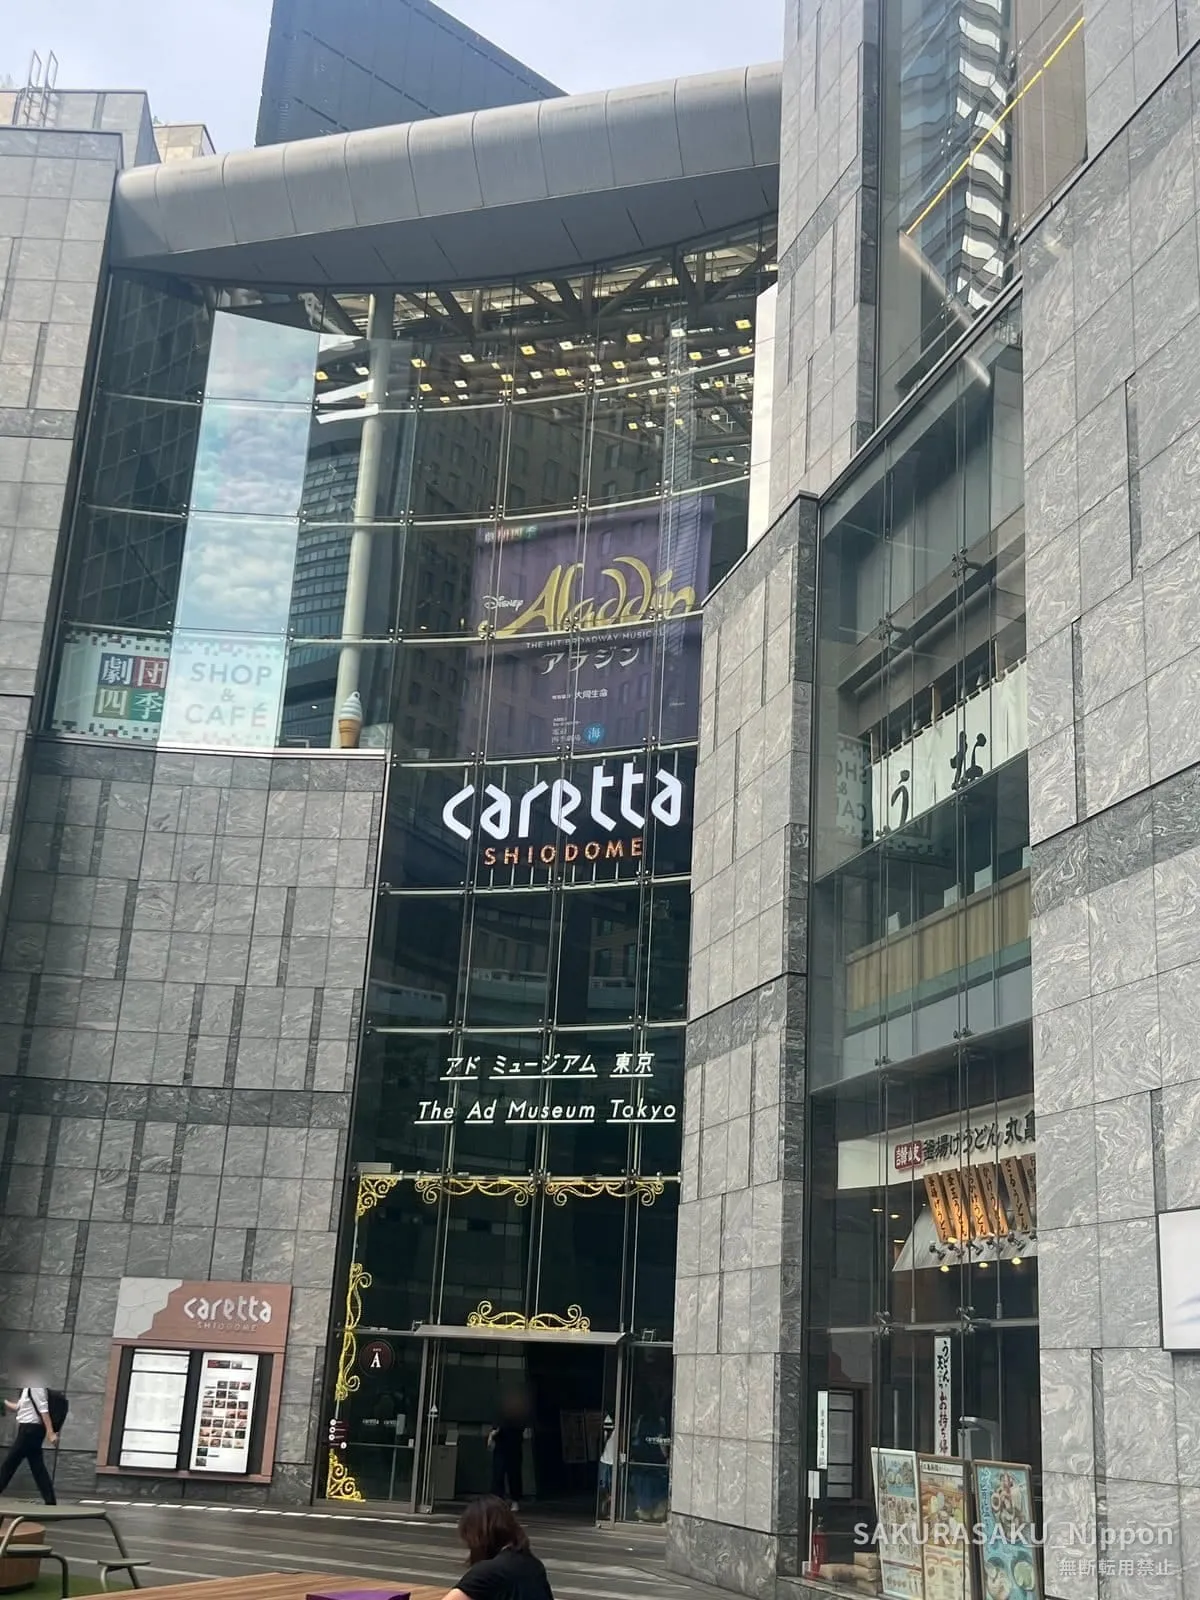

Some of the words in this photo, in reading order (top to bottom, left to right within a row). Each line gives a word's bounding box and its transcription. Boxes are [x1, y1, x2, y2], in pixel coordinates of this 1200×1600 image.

[478, 556, 696, 639] Aladdin
[526, 641, 544, 649] THE
[547, 639, 562, 647] HIT
[564, 634, 619, 646] BROADWAY
[622, 629, 665, 640] MUSICAL
[100, 655, 168, 689] 劇団
[540, 645, 640, 675] アラジン
[190, 661, 272, 688] SHOP
[97, 689, 163, 720] 四季
[220, 688, 235, 702] &
[185, 701, 269, 729] CAFÉ
[442, 762, 682, 840] caretta
[483, 837, 644, 866] SHIODOME
[446, 1055, 481, 1075] アド
[493, 1053, 597, 1075] ミュージアム
[614, 1052, 656, 1075] 東京
[418, 1100, 455, 1120] The
[466, 1099, 497, 1120] Ad
[507, 1100, 596, 1120] Museum
[609, 1097, 677, 1121] Tokyo
[183, 1295, 273, 1323] caretta
